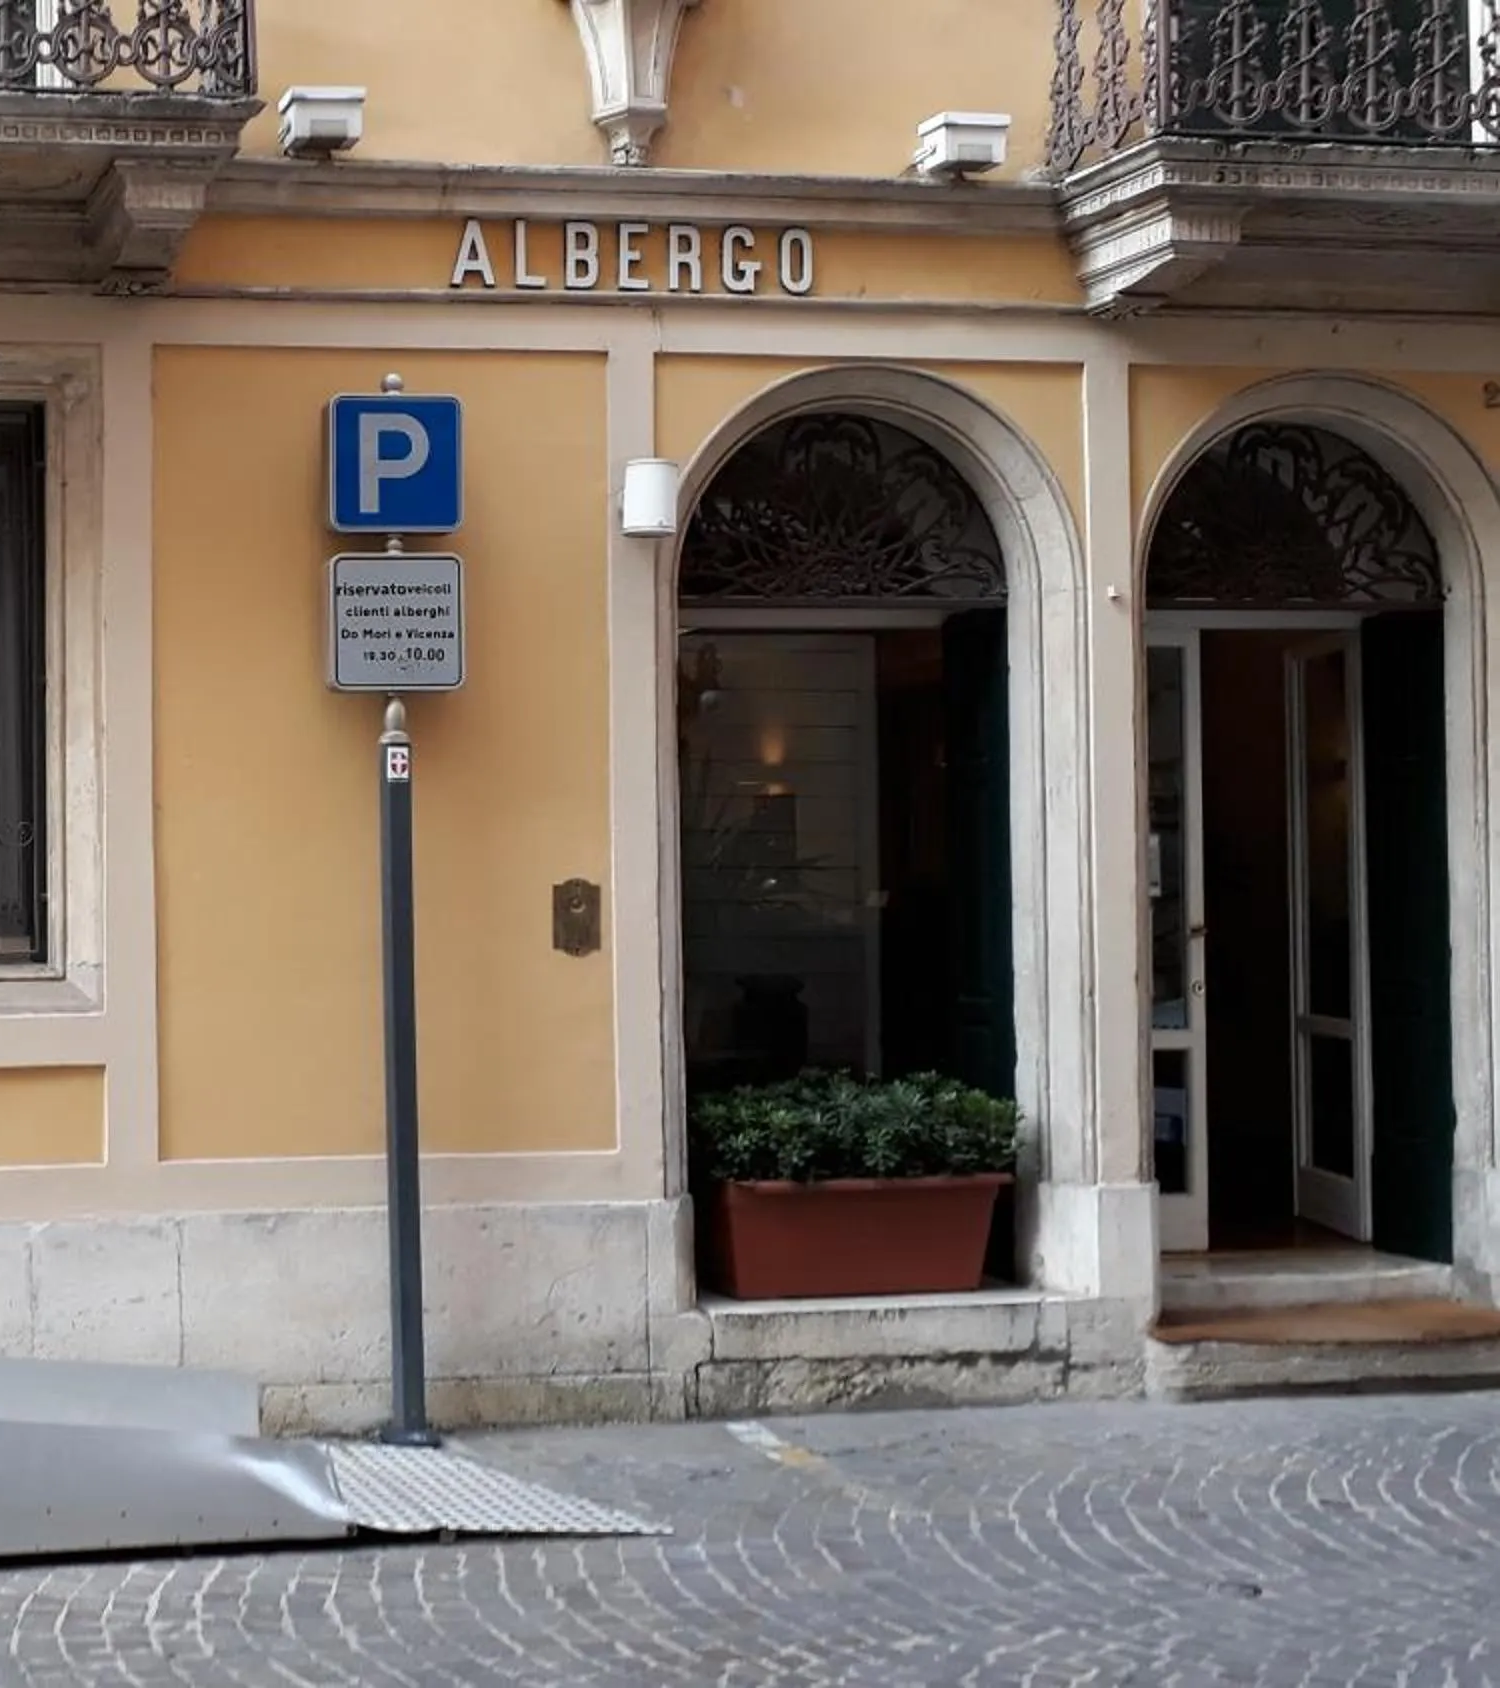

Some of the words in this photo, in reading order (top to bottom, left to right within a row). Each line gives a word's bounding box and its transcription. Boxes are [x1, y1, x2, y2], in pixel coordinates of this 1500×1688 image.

[449, 217, 814, 295] ALBERGO
[359, 413, 430, 514] P
[341, 628, 359, 639] Do
[363, 628, 391, 639] Mori
[405, 628, 455, 639] Vicenza
[345, 605, 389, 617] clienti
[393, 605, 451, 619] alberghi
